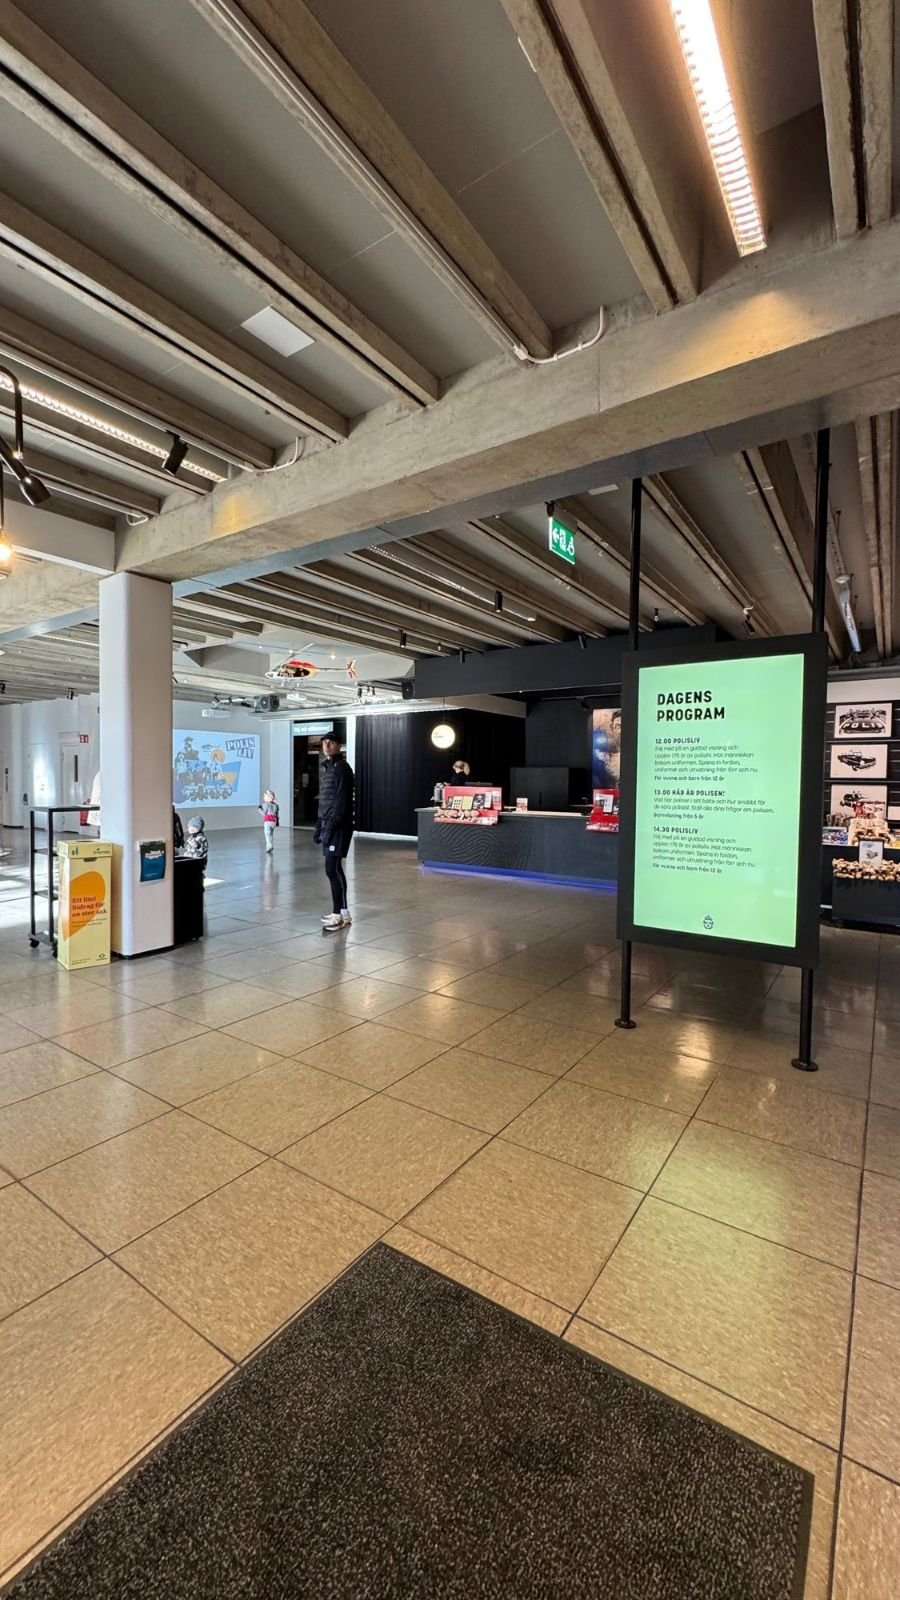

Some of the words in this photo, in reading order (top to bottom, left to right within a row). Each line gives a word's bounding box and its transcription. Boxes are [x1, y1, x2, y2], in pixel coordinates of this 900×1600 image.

[657, 690, 712, 705] DAGENS
[657, 706, 725, 721] PROGRAM
[225, 737, 256, 751] POLIS
[237, 748, 254, 759] LIV
